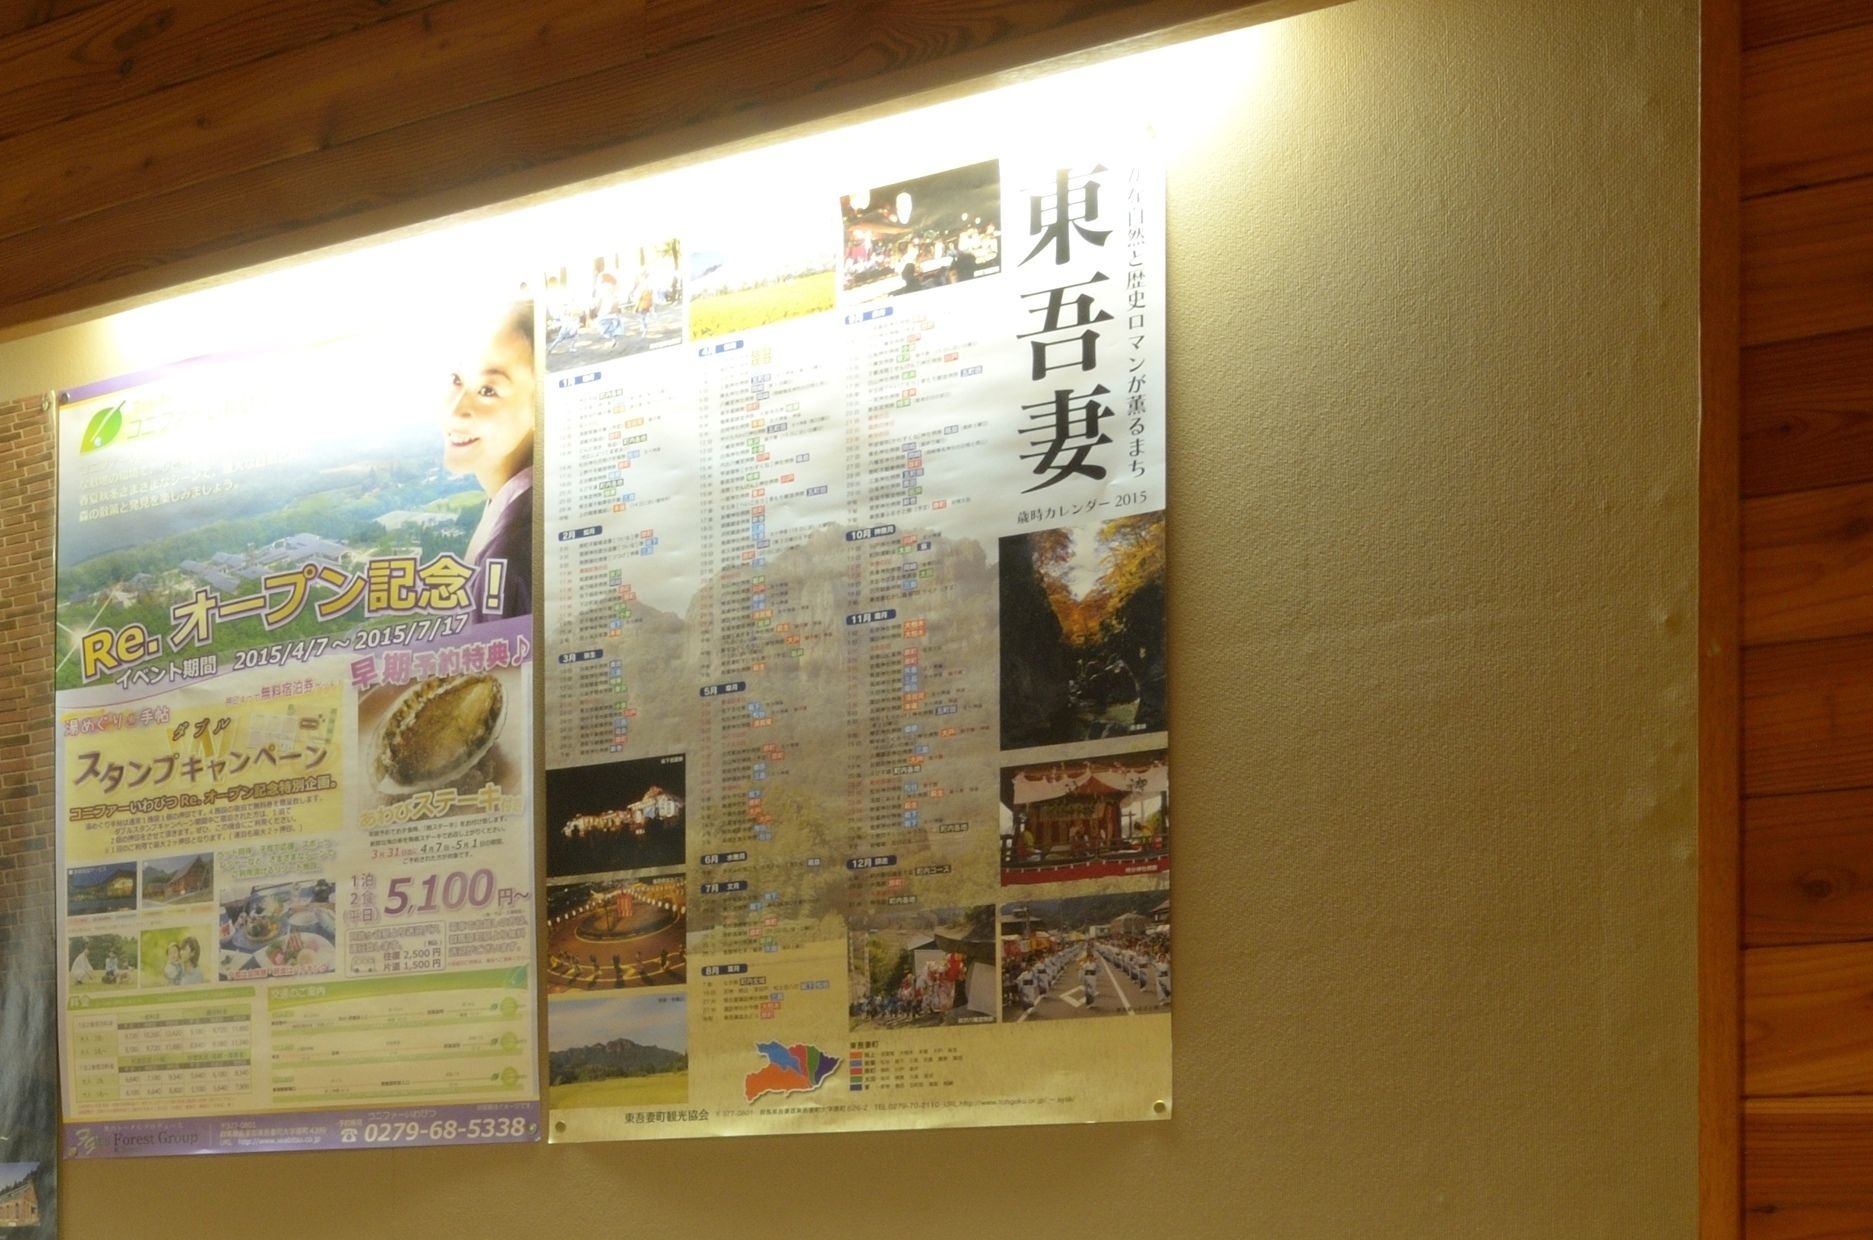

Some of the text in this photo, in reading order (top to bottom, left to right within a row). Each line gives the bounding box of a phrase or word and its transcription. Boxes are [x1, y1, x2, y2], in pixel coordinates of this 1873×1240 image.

[1016, 163, 1115, 495] 東吾妻
[1017, 490, 1148, 524] 歳時カレンダー 2015
[851, 528, 871, 541] 10月
[851, 612, 872, 625] 11月
[81, 622, 161, 684] Re.
[562, 652, 577, 664] 3月
[116, 654, 216, 690] イベント期間
[703, 685, 718, 697] 5月
[173, 717, 231, 741] ダブル
[74, 743, 328, 793] スタンプキャンペーン
[69, 796, 177, 821] コニファーいわびつ
[203, 775, 337, 804] オープン記念特別企画。
[705, 855, 719, 865] 6月
[852, 857, 872, 869] 12月
[351, 873, 375, 888] 1泊
[384, 868, 494, 915] 5,100
[705, 884, 719, 894] 7月
[350, 891, 375, 906] 2食
[705, 966, 720, 976] 8月
[624, 1109, 709, 1124] 東吾妻町観光協会
[364, 1116, 525, 1143] 0279-68-5338
[114, 1129, 199, 1146] Forest Group
